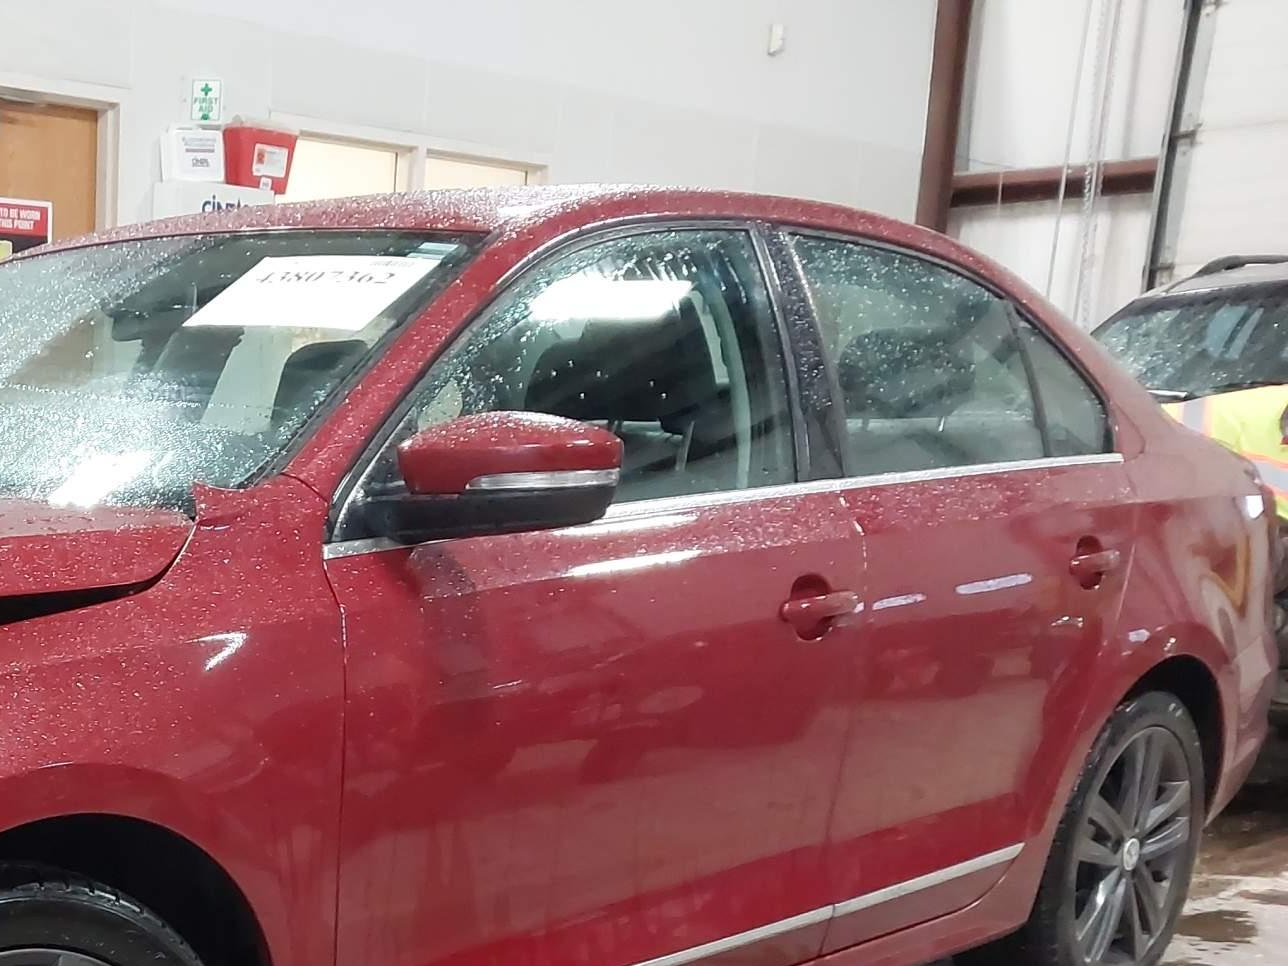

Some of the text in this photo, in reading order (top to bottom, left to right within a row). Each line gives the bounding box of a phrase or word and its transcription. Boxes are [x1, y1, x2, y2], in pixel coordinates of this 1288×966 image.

[0, 207, 8, 217] TO
[9, 208, 18, 219] BE
[19, 209, 41, 220] WORN
[13, 219, 34, 230] POINT
[256, 270, 396, 284] 43807362
